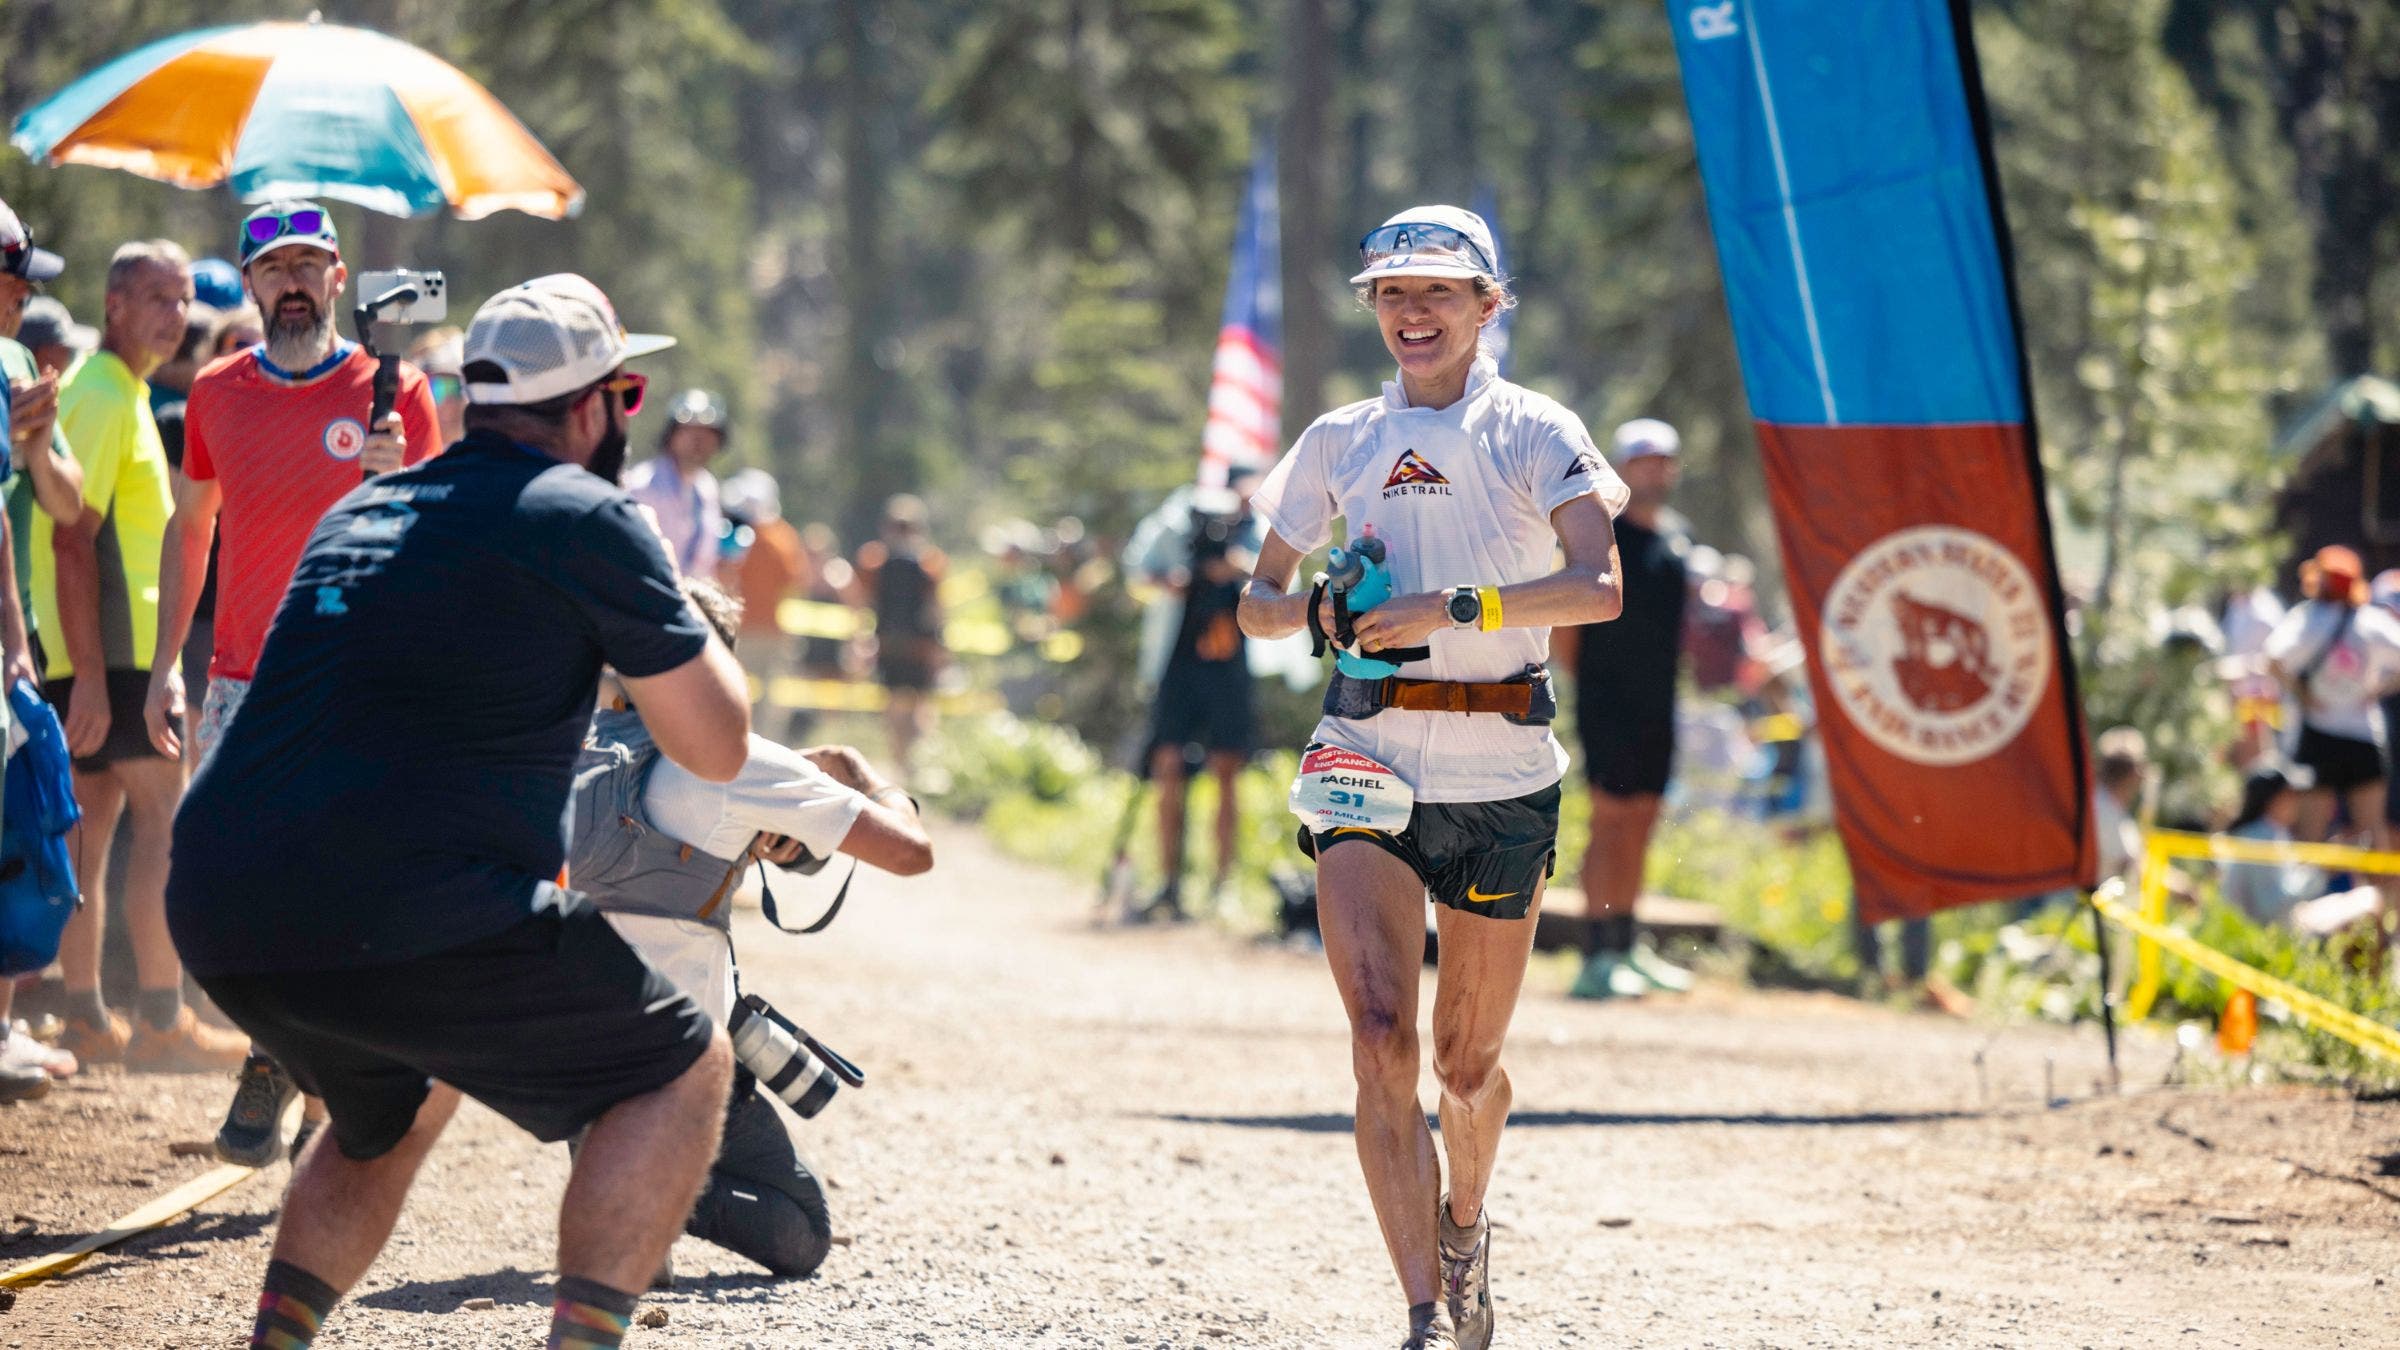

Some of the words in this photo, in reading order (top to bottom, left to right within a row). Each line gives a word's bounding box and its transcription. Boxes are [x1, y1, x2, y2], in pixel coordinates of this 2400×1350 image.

[1382, 486, 1408, 500] NIKE
[1411, 485, 1453, 496] TRAIL
[1314, 757, 1373, 768] ENDRANCE
[1328, 790, 1364, 807] 31
[1334, 811, 1371, 822] MILES
